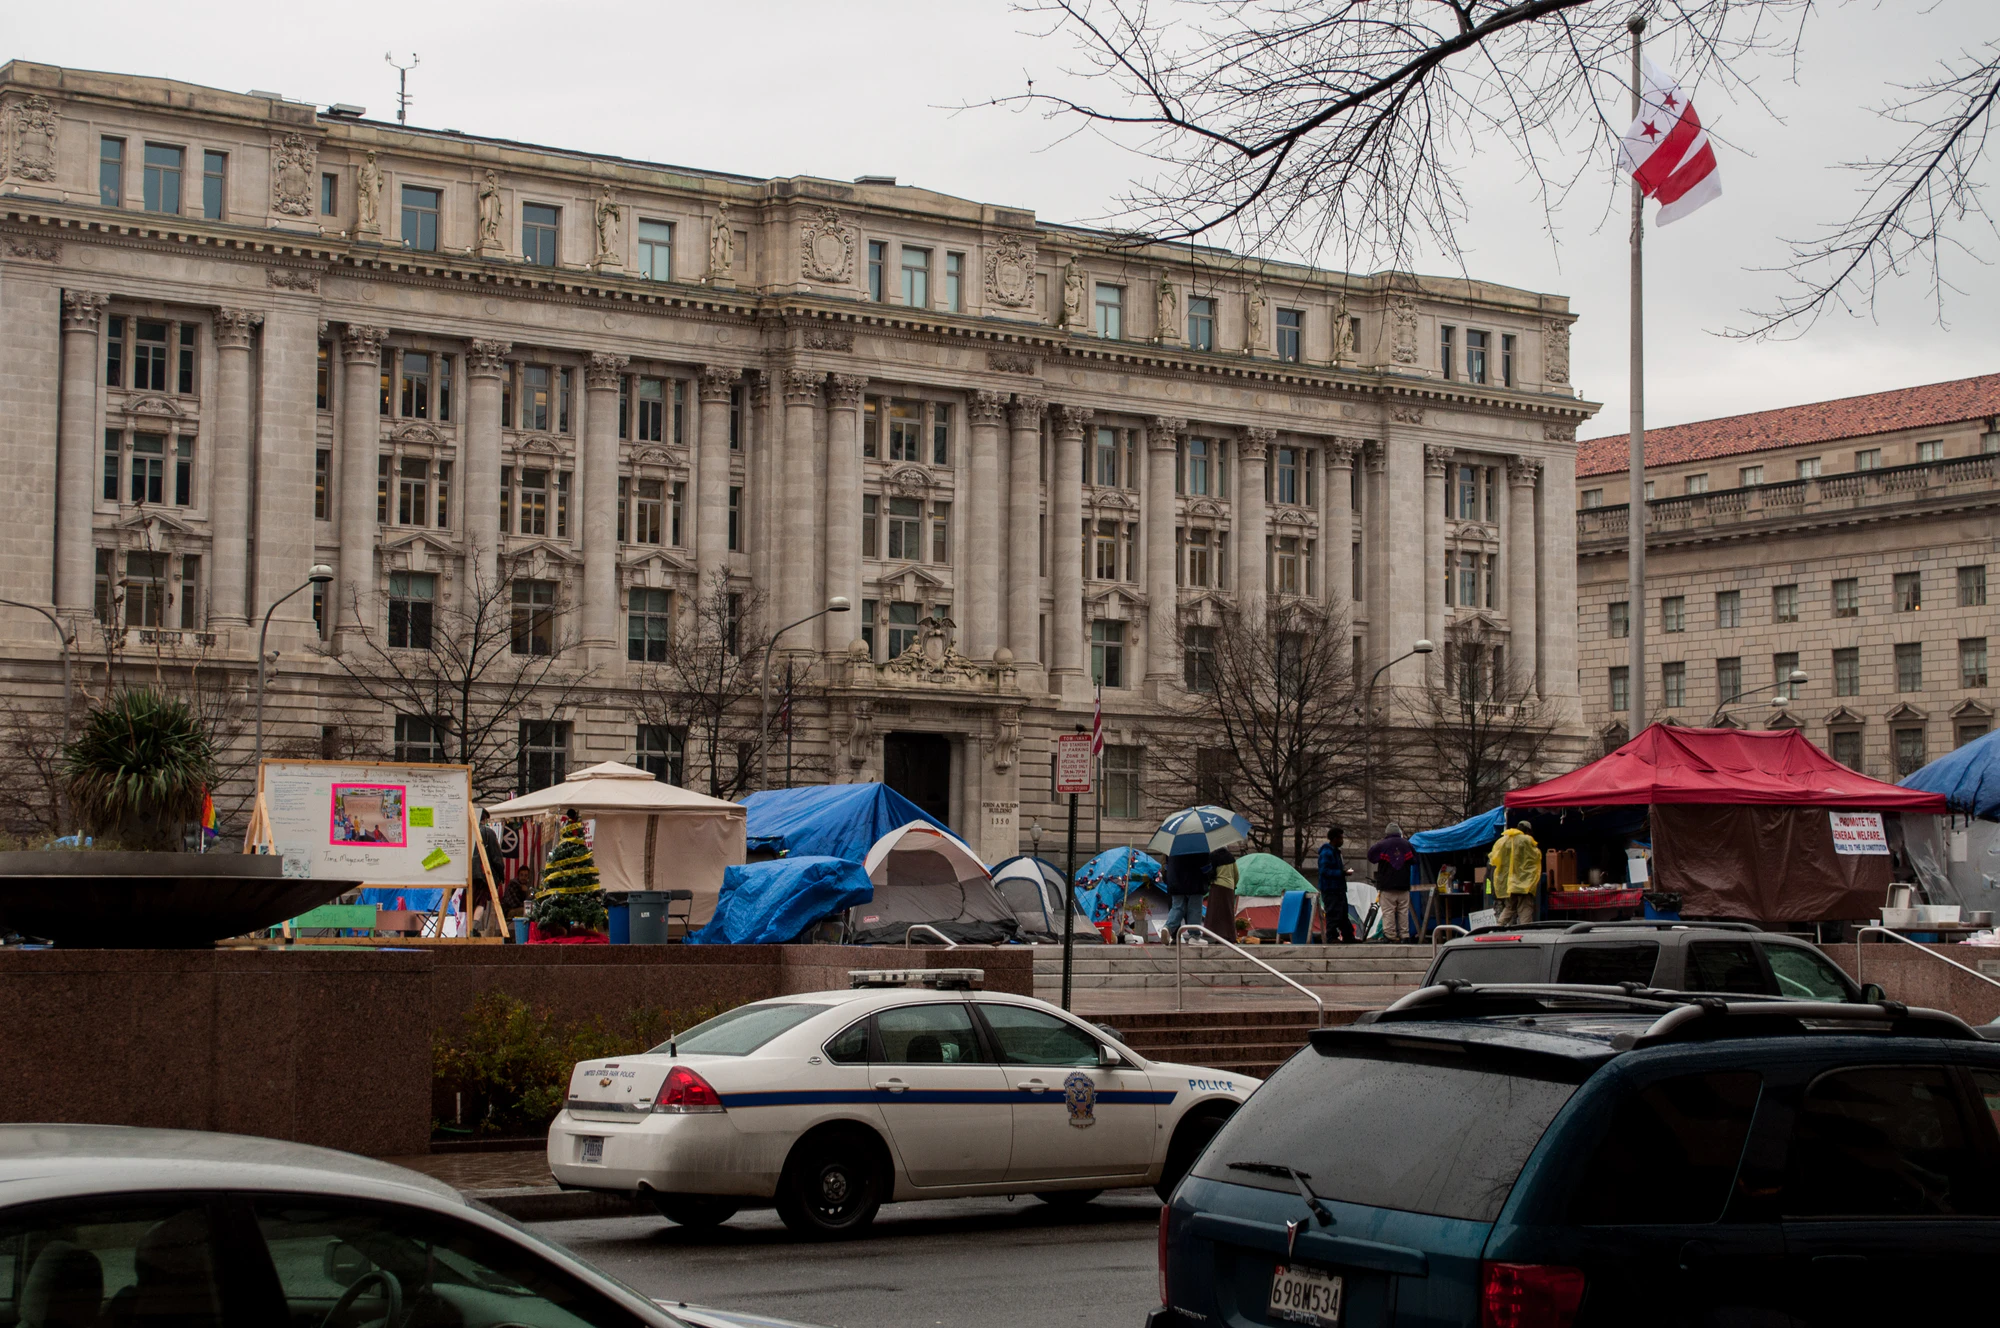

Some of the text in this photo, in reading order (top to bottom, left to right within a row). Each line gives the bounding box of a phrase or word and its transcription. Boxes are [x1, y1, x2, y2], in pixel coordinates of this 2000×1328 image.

[1865, 818, 1877, 827] THE
[1188, 1079, 1235, 1091] POLICE
[1272, 1278, 1339, 1315] 698M534
[1174, 1306, 1207, 1322] TORRENT
[1283, 1308, 1321, 1327] CAPITOL
